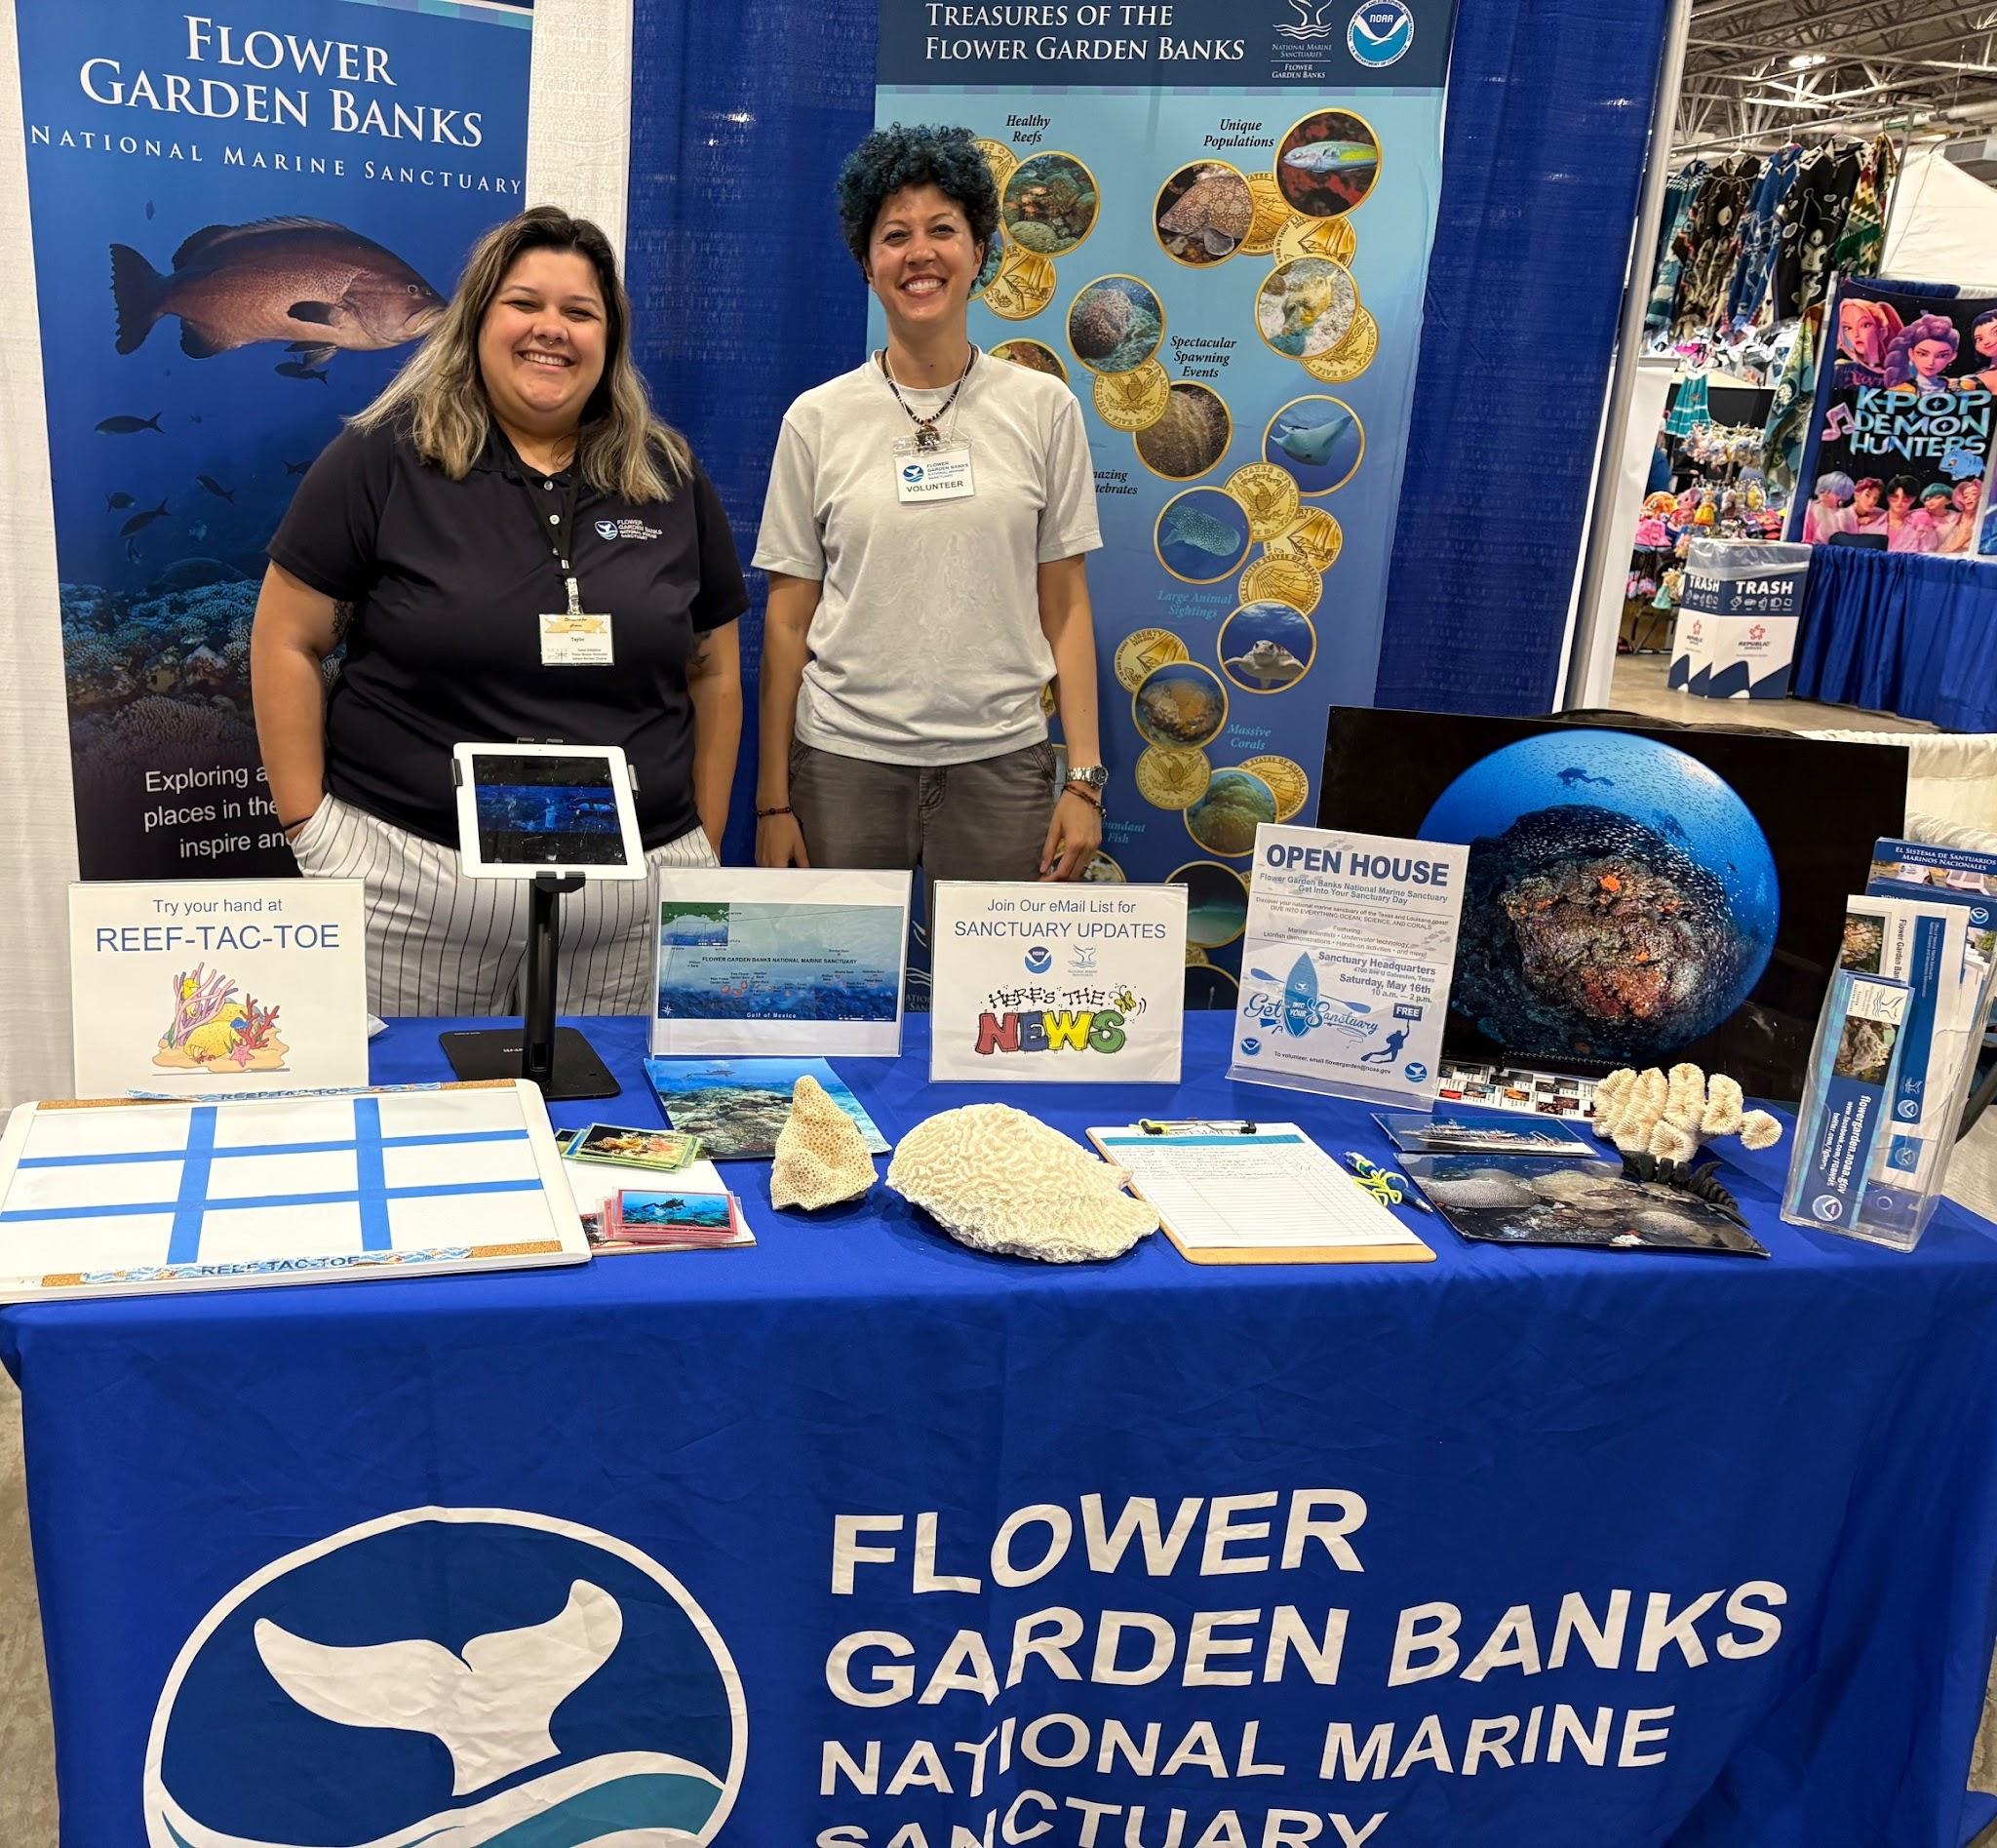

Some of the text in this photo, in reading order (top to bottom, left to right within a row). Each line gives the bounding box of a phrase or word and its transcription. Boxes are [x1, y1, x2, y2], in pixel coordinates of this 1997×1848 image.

[926, 3, 1173, 26] TREASURES OF THE
[1369, 14, 1393, 23] NOAA
[183, 16, 397, 86] FLOWER
[926, 36, 1245, 60] FLOWER GARDEN BANKS
[80, 59, 482, 147] GARDEN BANKS
[1005, 115, 1051, 130] Healthy
[1220, 119, 1262, 132] Unique
[1012, 131, 1042, 145] Reefs
[1203, 135, 1274, 150] Populations
[31, 125, 522, 194] NATIONAL MARINE SANCTUARY
[1170, 335, 1236, 350] Spectacular
[1174, 350, 1231, 367] Spawning
[1182, 367, 1219, 378] Events
[1856, 385, 1992, 417] KPOP
[1855, 407, 1991, 439] DEMON
[1849, 432, 1986, 462] HUNTERS
[906, 480, 963, 492] VOLUNTEER
[1095, 483, 1138, 494] tebrates
[1689, 575, 1720, 593] TRASH
[1736, 580, 1794, 594] TRASH
[1157, 589, 1233, 605] Large Animal
[1168, 604, 1218, 620] Sightings
[1227, 724, 1272, 738] Massive
[1231, 737, 1266, 750] Corals
[145, 766, 249, 795] Exploring
[144, 796, 279, 833] places in the
[179, 833, 252, 858] inspire
[1107, 831, 1130, 844] Fish
[1266, 844, 1449, 886] OPEN HOUSE
[1902, 854, 1986, 871] MARINOS NACIONALES
[1905, 847, 1936, 858] SISTEMA
[1950, 853, 1996, 866] SANTUARIOS
[1260, 873, 1448, 904] Flower Garden Banks National Marine Sanctuary
[1298, 885, 1312, 893] Get
[1331, 888, 1350, 897] Your
[1351, 890, 1390, 903] Sanctuary
[1392, 896, 1408, 906] Day
[152, 898, 283, 917] Try your hand at
[987, 899, 1136, 914] Join Our eMail List for
[1256, 896, 1278, 905] Discover
[1300, 909, 1338, 919] EVERYTHING
[97, 924, 339, 953] REEF-TAC-TOE
[955, 922, 1166, 939] SANCTUARY UPDATES
[1894, 919, 1907, 978] Flower Garden Ban
[1318, 951, 1436, 975] Sanctuary Headquarters
[1340, 973, 1431, 995] Saturday, May 16th
[989, 986, 1105, 1008] HERE'S THE
[1416, 995, 1432, 1003] p.m.
[1243, 993, 1379, 1035] Get Sanctuary
[1289, 1008, 1307, 1017] YOUR
[1396, 1006, 1420, 1018] FREE
[975, 1009, 1125, 1054] NEWS
[1325, 1059, 1391, 1074] flowergarden@noaa.gov
[1837, 1094, 1872, 1195] flowergarden.noaa.gov
[830, 1488, 1367, 1596] FLOWER
[824, 1580, 1787, 1708] GARDEN BANKS
[819, 1704, 1675, 1798] NATIONAL MARINE
